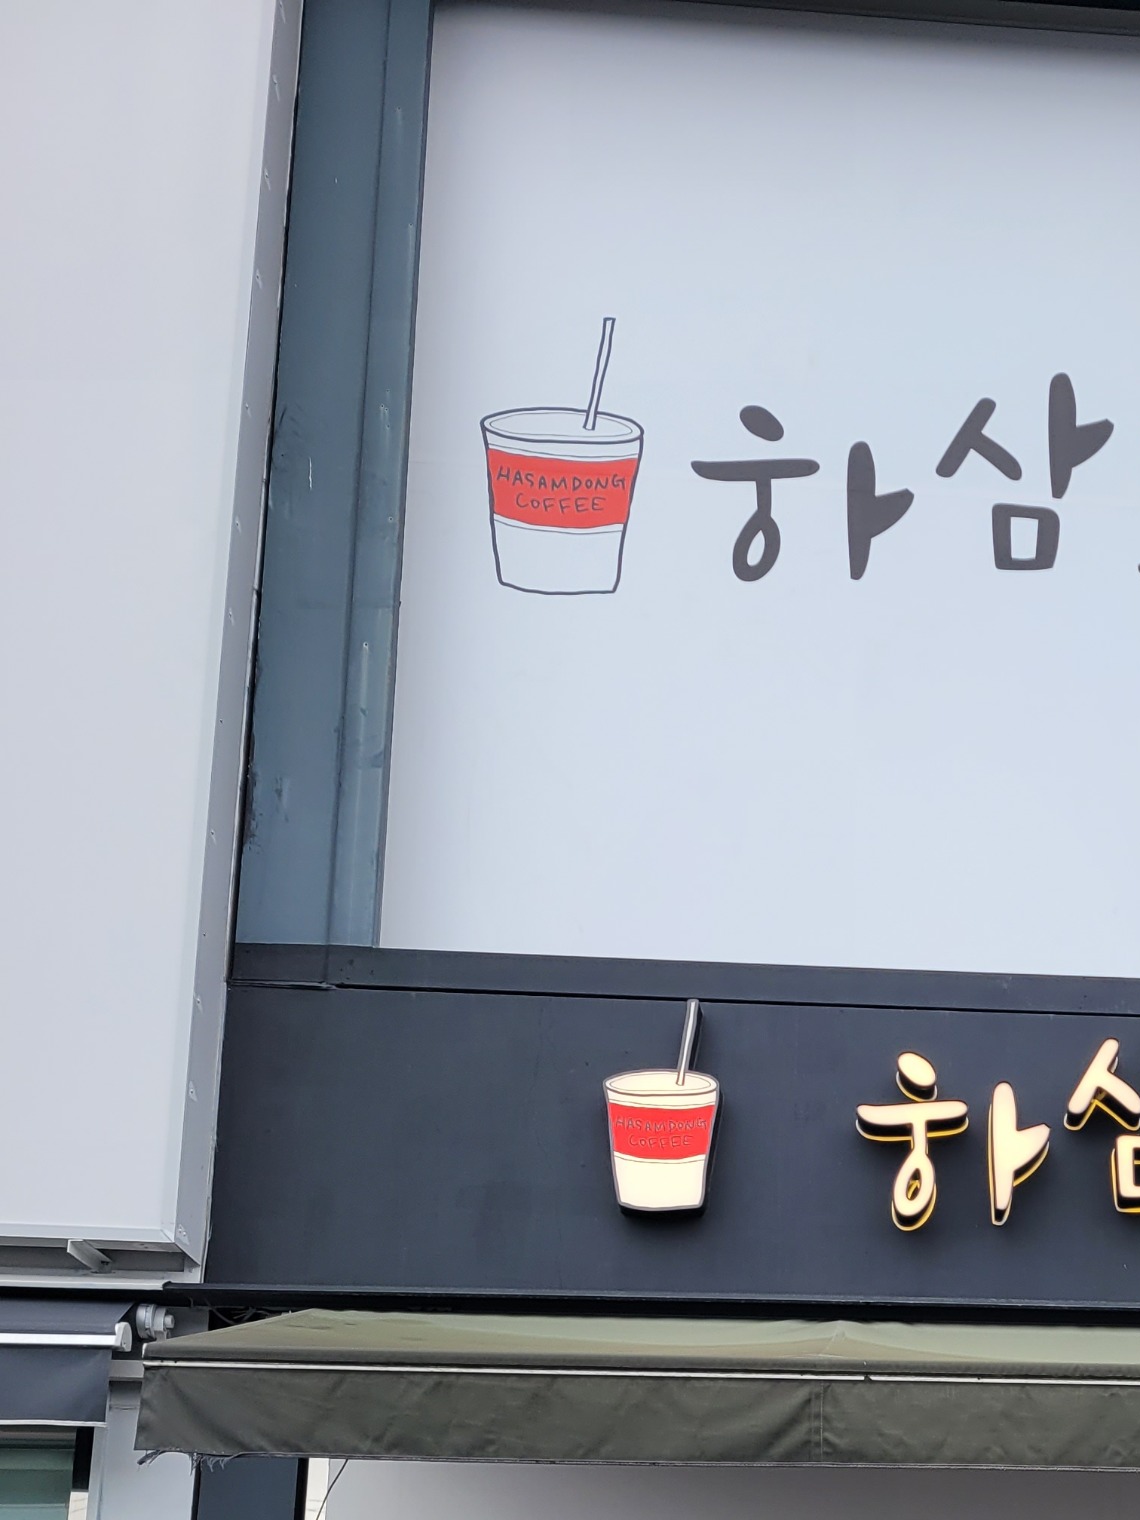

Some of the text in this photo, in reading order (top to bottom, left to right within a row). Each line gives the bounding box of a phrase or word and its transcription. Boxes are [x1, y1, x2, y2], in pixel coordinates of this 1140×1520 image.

[496, 464, 626, 492] HASAMDONG
[515, 492, 606, 514] COFFEE
[615, 1116, 709, 1133] HASAMDONG
[628, 1134, 693, 1150] COFFEE
